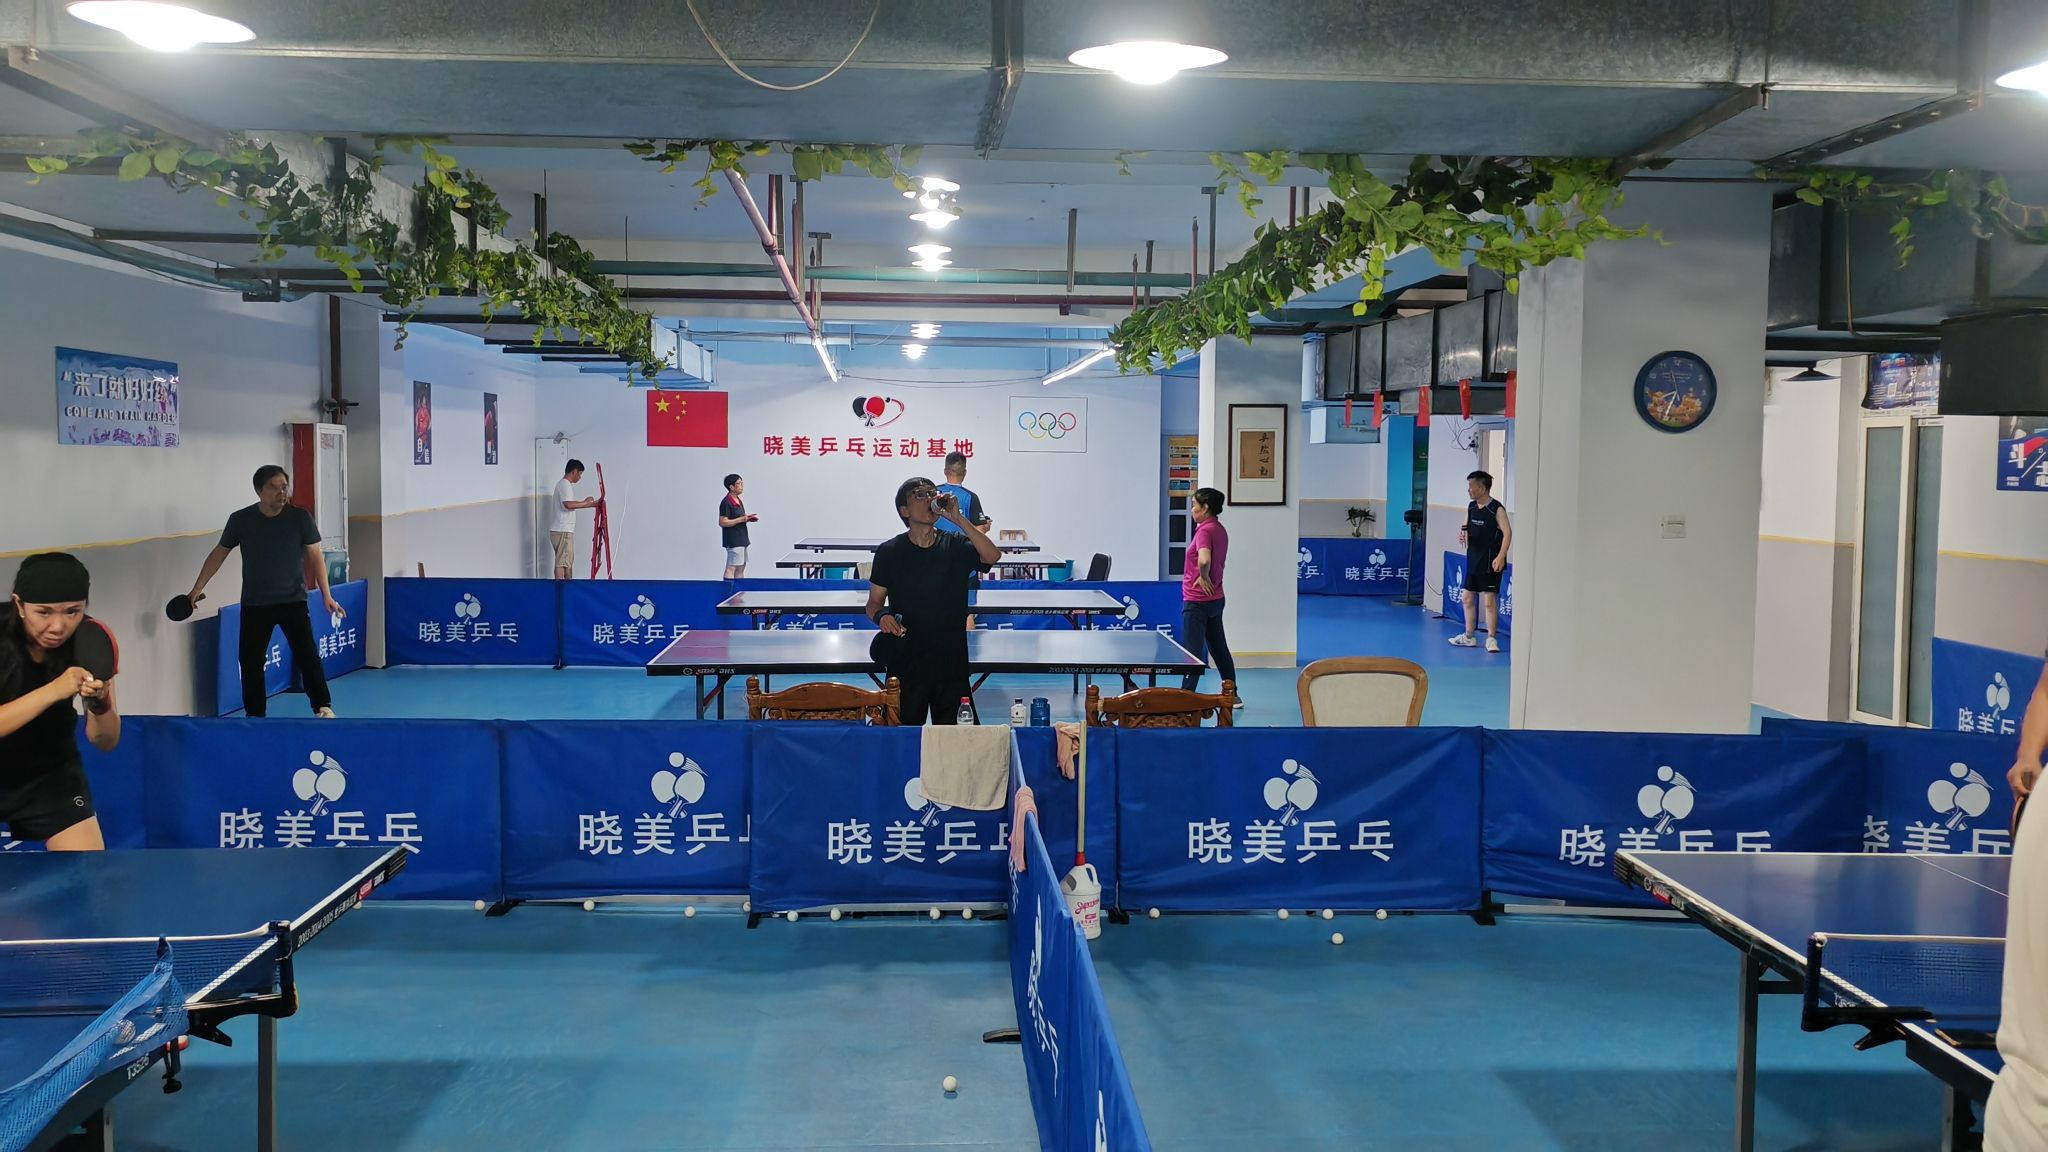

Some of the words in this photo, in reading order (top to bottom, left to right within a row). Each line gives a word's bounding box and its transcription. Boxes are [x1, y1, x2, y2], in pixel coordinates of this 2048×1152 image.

[65, 405, 92, 418] COME
[96, 408, 115, 420] AND
[117, 410, 143, 421] TRAIN
[145, 411, 177, 423] HARDER
[763, 434, 974, 458] 晓美乒乓运动基地
[318, 627, 356, 660] 晓美乒乓
[418, 621, 519, 643] 晓美乒乓
[219, 807, 423, 854] 晓美乒乓
[578, 810, 750, 855] 晓美乒
[1188, 817, 1394, 864] 晓美乒乓
